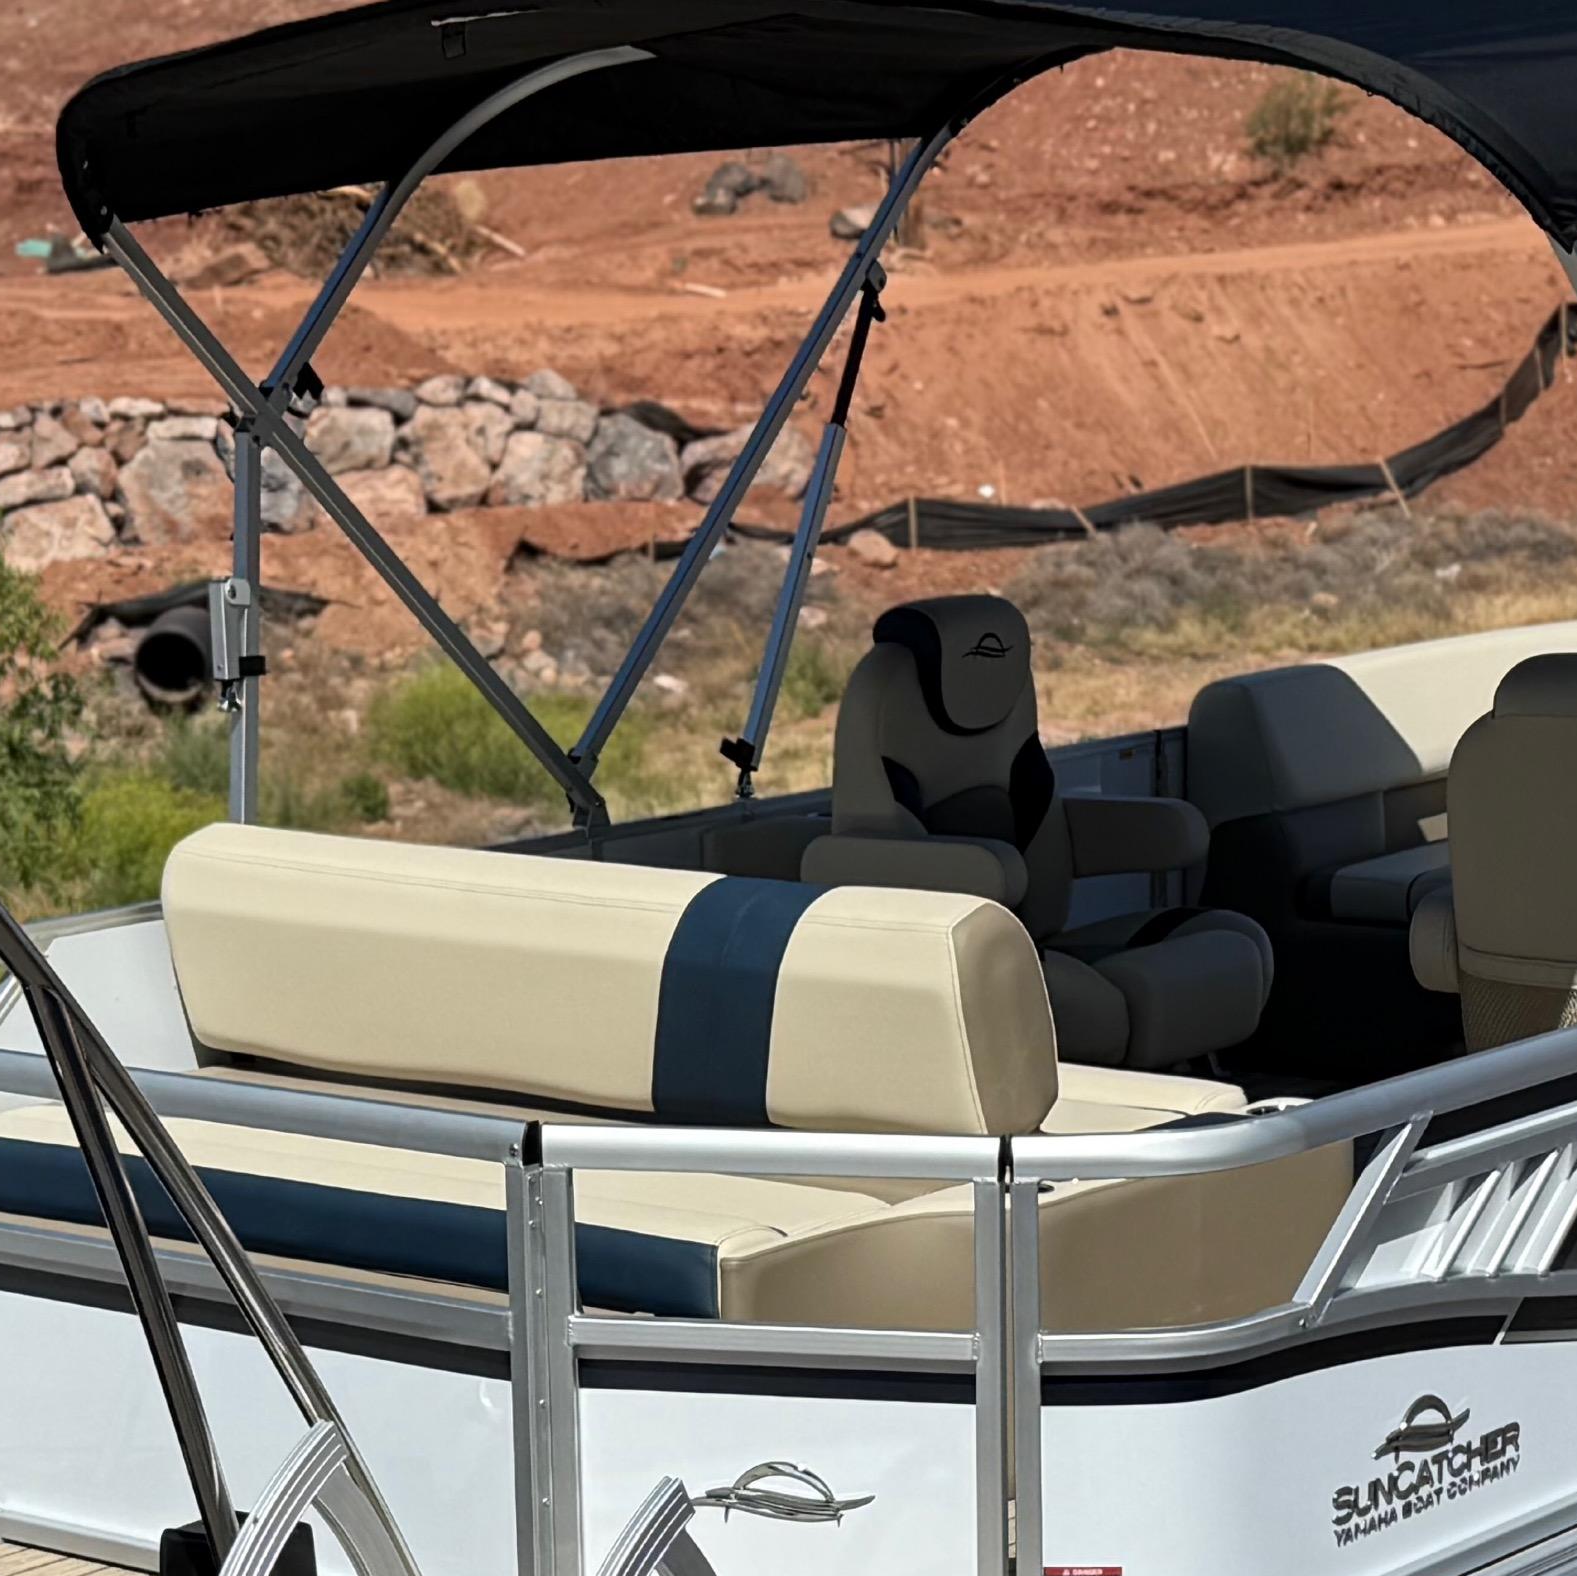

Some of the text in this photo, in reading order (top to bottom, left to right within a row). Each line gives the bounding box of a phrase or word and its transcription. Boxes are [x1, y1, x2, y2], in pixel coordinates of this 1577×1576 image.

[1331, 1421, 1521, 1526] SUNCATCHER
[1333, 1453, 1521, 1548] YAMAHA BOAT COMPANY
